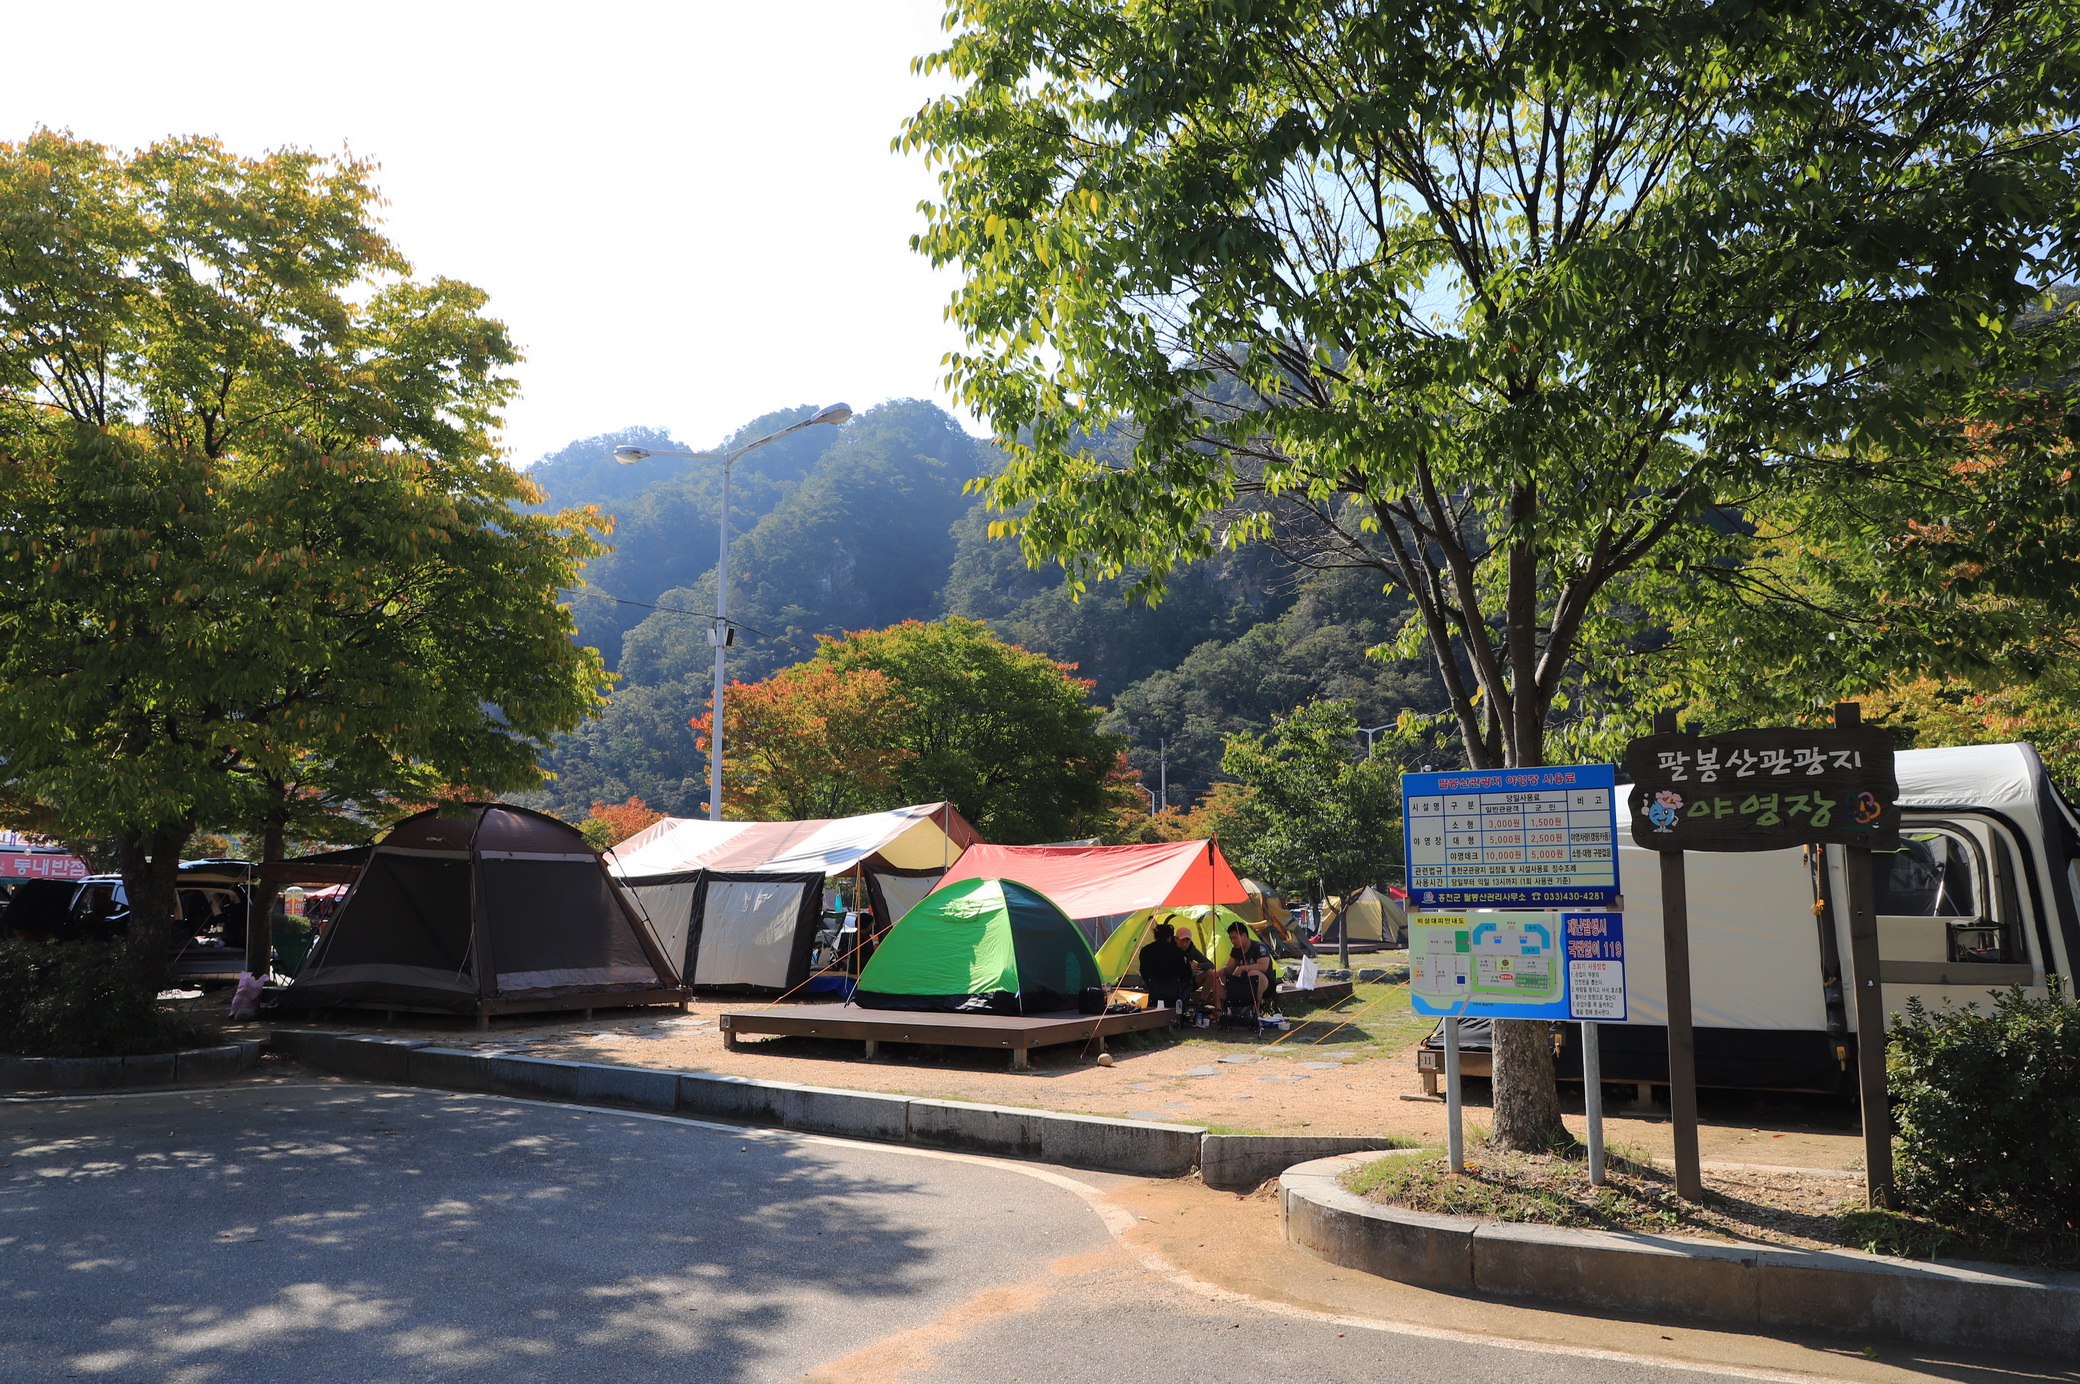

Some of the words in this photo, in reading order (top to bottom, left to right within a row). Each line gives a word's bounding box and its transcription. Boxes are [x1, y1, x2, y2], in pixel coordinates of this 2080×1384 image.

[1657, 746, 1862, 783] 팔봉산관광지
[1438, 776, 1502, 789] 팔봉산관광지
[1505, 775, 1539, 786] 야영장
[1542, 773, 1576, 784] 사용료
[1506, 794, 1540, 802] 당일사용료
[1486, 805, 1520, 813] 일반관광객
[1687, 790, 1837, 828] 야영장
[1488, 819, 1520, 829] 3,000원
[1531, 817, 1562, 828] 1,500원
[1490, 835, 1520, 845] 5,000원
[1531, 834, 1563, 844] 2,500원
[1450, 852, 1478, 861] 야영데크
[1486, 851, 1522, 860] 10,000원
[1532, 850, 1564, 860] 5,000원
[14, 858, 86, 877] 동내반점
[1415, 866, 1442, 876] 관련법규
[1451, 866, 1487, 875] 홍천군관광지
[1519, 865, 1549, 873] 시설사용료
[1416, 878, 1443, 888] 사용시간
[1452, 878, 1475, 886] 당일부터
[1492, 878, 1517, 886] 13시까지
[1535, 877, 1552, 885] 사용권
[1557, 877, 1571, 885] 기준)
[1438, 893, 1461, 903] 홍천군
[1464, 892, 1526, 902] 팔봉산관리사무소
[1544, 892, 1604, 901] 033)430-4281
[1567, 918, 1607, 936] 재난발생시
[1568, 940, 1600, 958] 국번없이
[1603, 940, 1622, 958] 119
